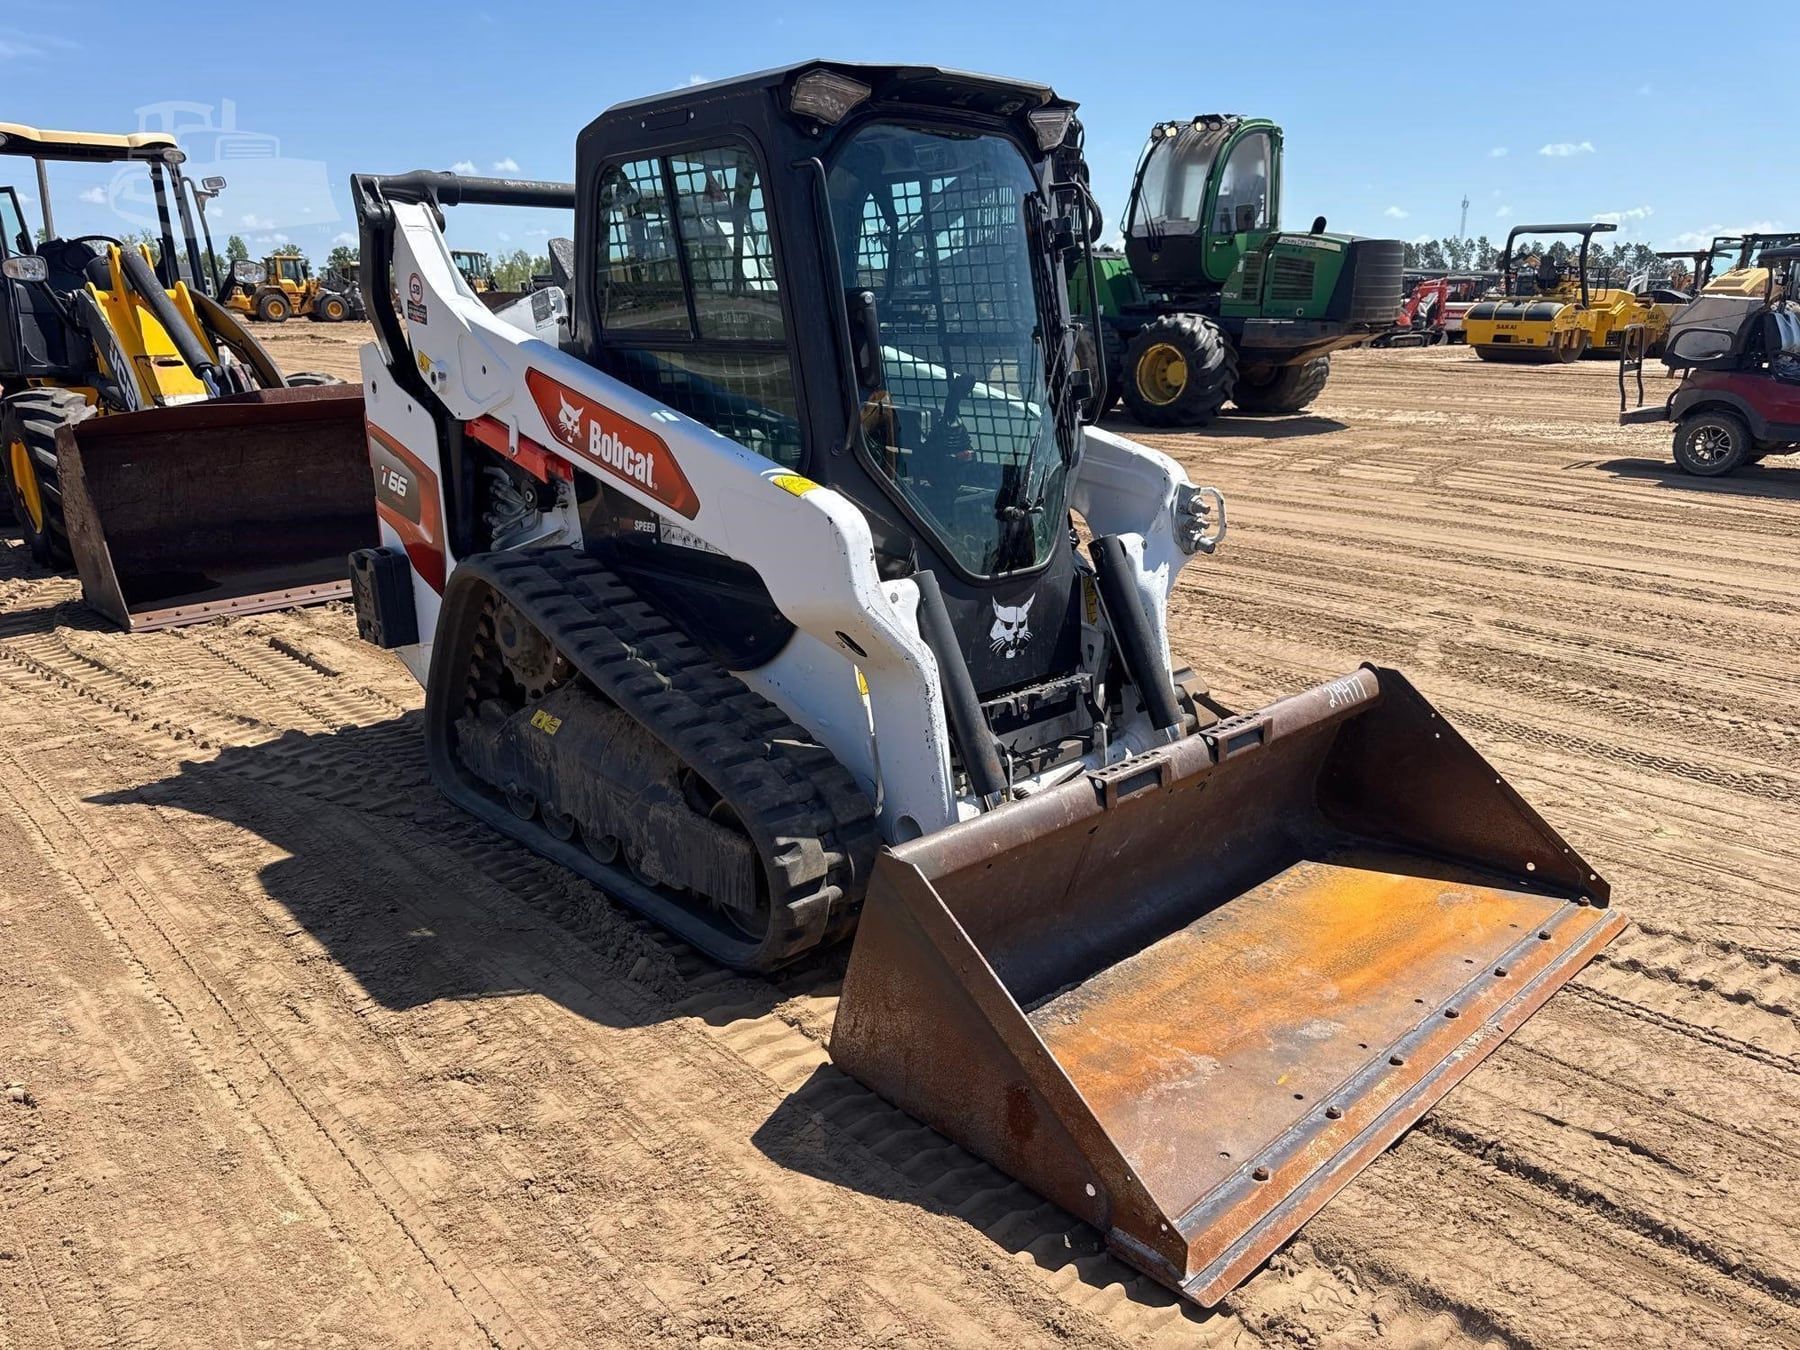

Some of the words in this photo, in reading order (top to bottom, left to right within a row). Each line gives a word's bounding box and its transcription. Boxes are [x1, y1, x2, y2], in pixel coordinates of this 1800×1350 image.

[109, 342, 136, 412] JCB
[588, 418, 655, 489] Bobcat
[380, 464, 409, 498] T66
[633, 519, 657, 534] SPEED
